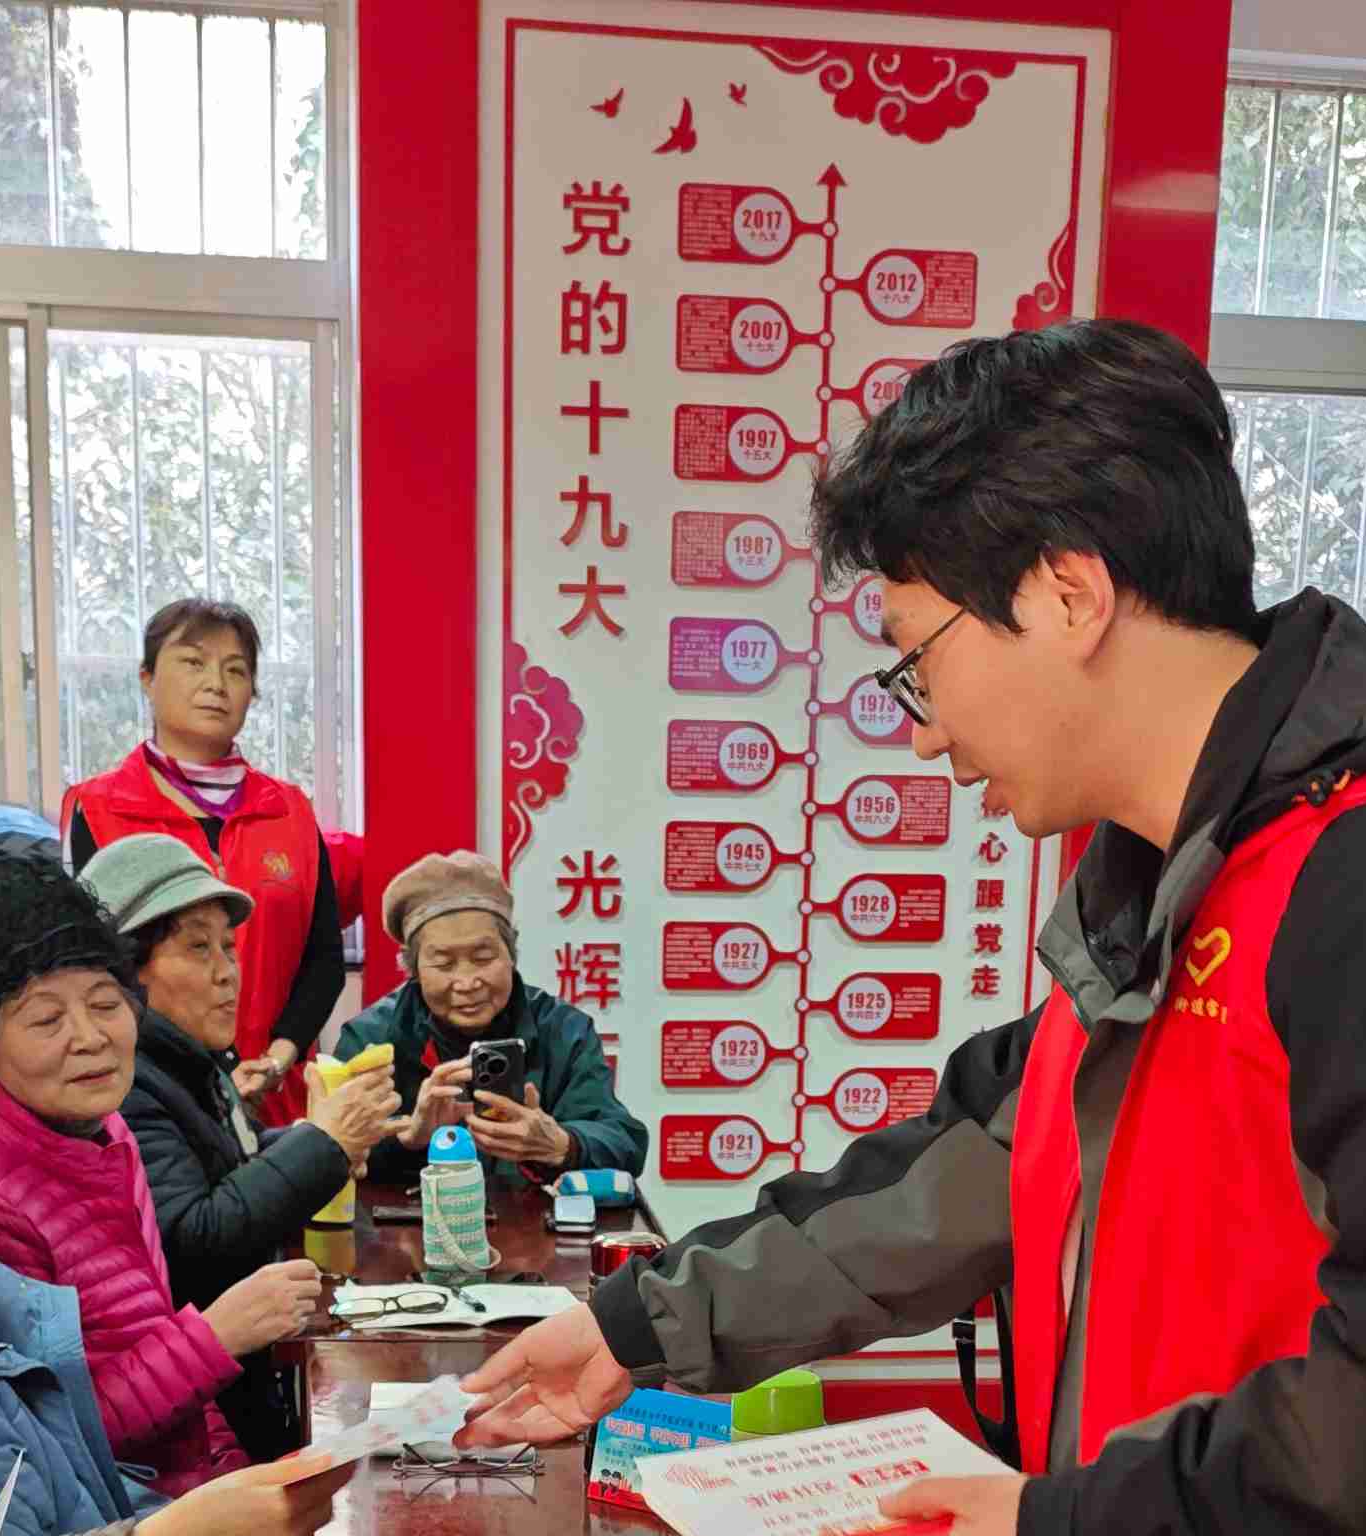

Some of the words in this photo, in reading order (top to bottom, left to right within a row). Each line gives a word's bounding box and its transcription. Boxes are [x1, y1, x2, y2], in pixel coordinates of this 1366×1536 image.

[742, 209, 782, 229] 2017
[876, 271, 917, 292] 2012
[739, 320, 782, 340] 2007
[872, 382, 904, 400] 200
[558, 180, 631, 637] 党的十九大
[737, 429, 777, 449] 1997
[733, 535, 773, 555] 1987
[863, 594, 882, 612] 19
[731, 640, 768, 658] 1977
[858, 695, 897, 712] 1973
[727, 742, 769, 761] 1969
[854, 796, 896, 814] 1956
[724, 843, 765, 861] 1945
[850, 895, 890, 913] 1928
[721, 942, 759, 960] 1927
[847, 991, 885, 1009] 1925
[720, 1039, 758, 1057] 1923
[843, 1087, 881, 1104] 1922
[717, 1134, 754, 1152] 1921
